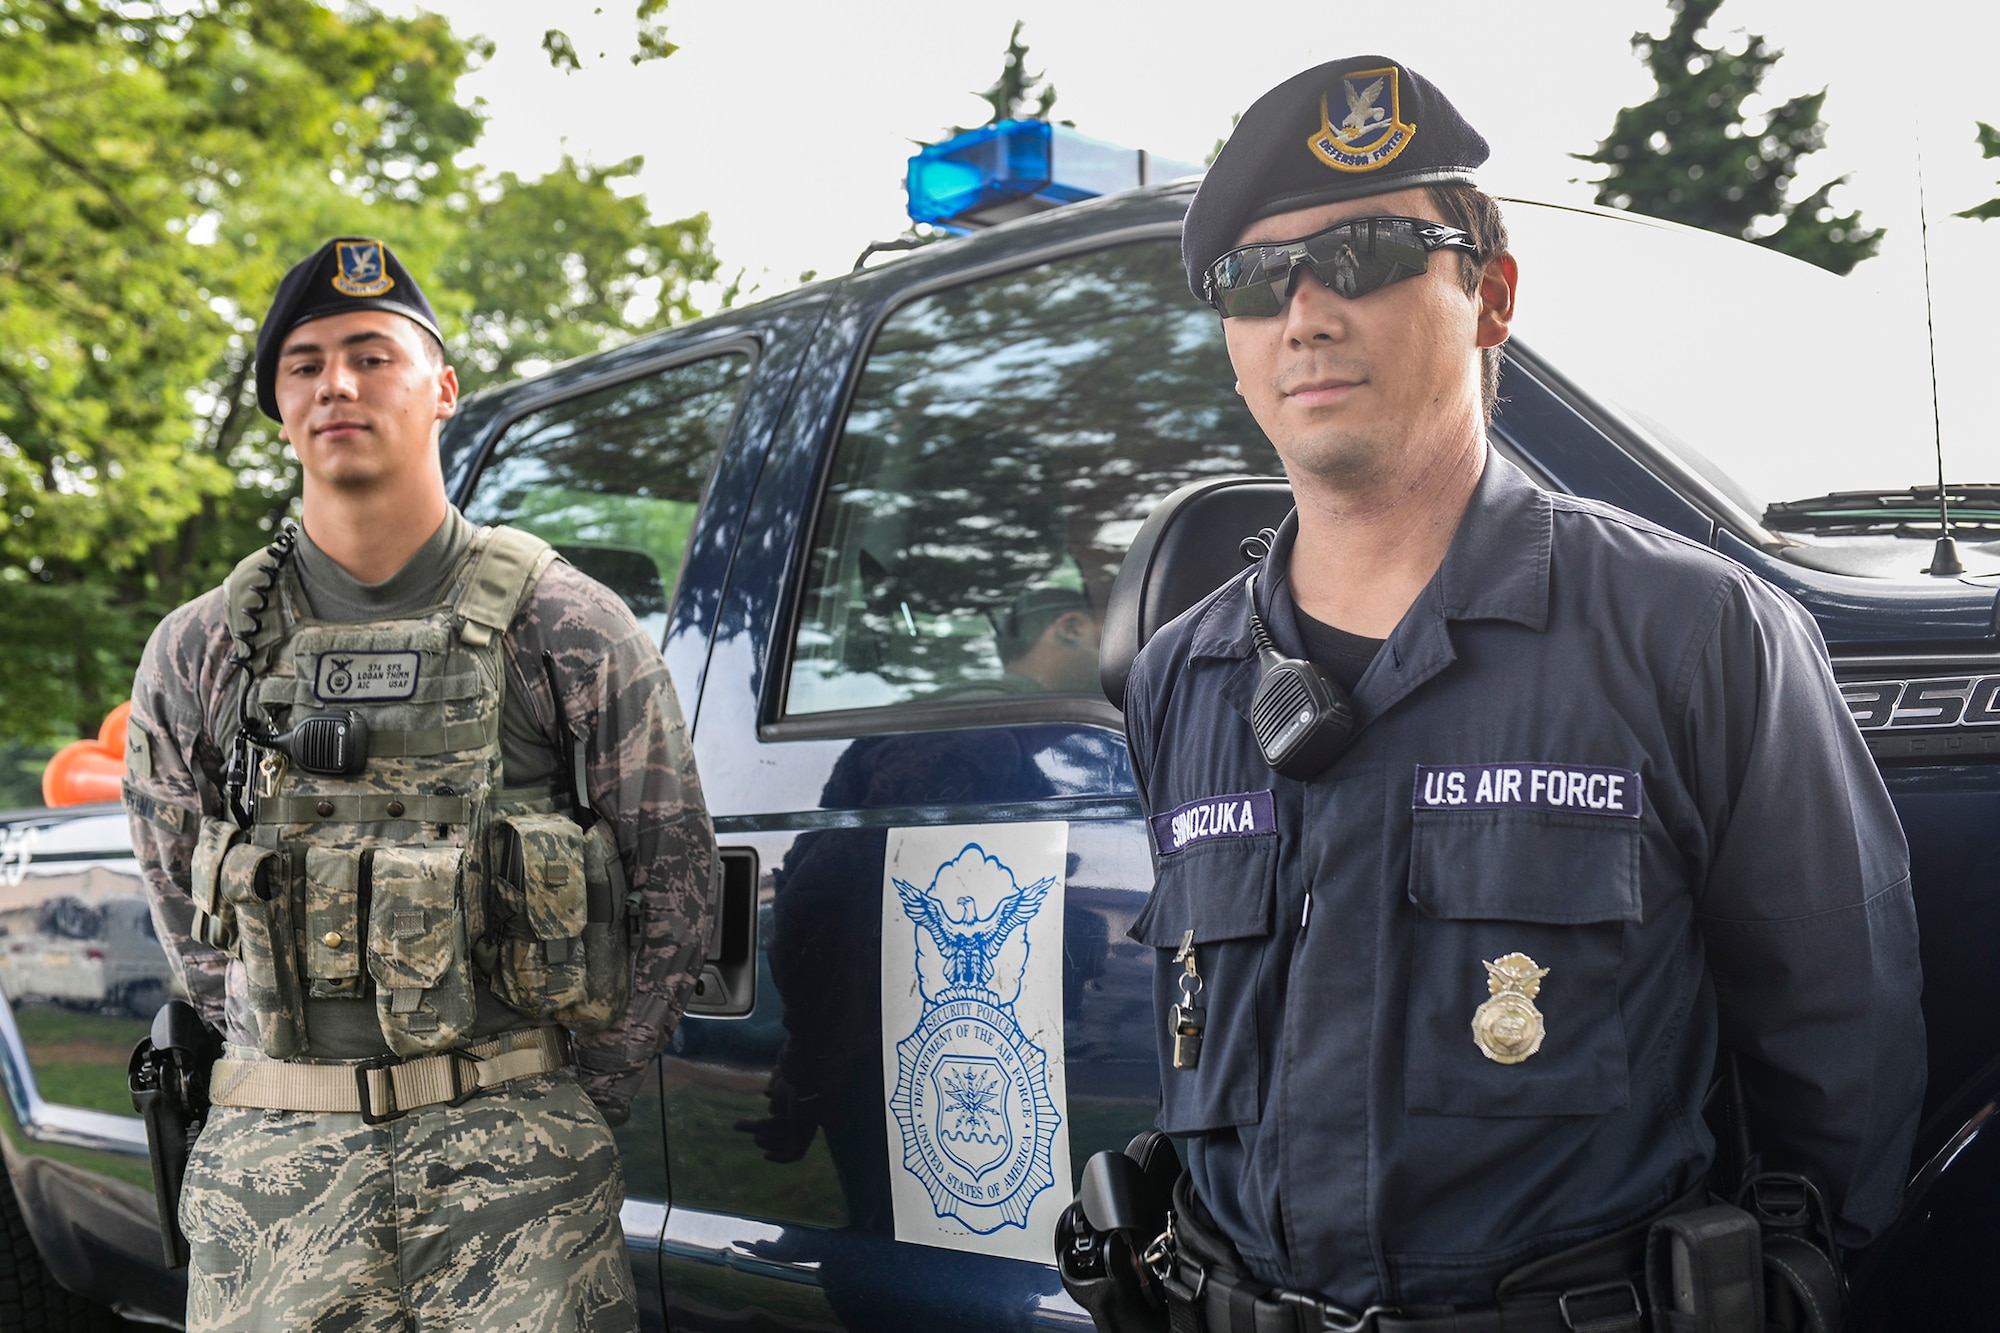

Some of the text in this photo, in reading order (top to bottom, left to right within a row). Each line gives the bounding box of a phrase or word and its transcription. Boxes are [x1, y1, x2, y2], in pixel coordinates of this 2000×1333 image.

[1319, 130, 1404, 166] DEFENSOR FORTIS
[386, 663, 403, 672] SFS
[388, 680, 408, 688] USAF
[1269, 721, 1300, 755] MOTOROLA
[1424, 768, 1626, 811] U.S. AIR FORCE
[926, 1002, 1013, 1036] SECURITY POLICE
[914, 1024, 1033, 1118] DEPARTMENT OF THE AIR FORCE
[917, 1123, 1032, 1200] UNITED STATES OF AMERICA
